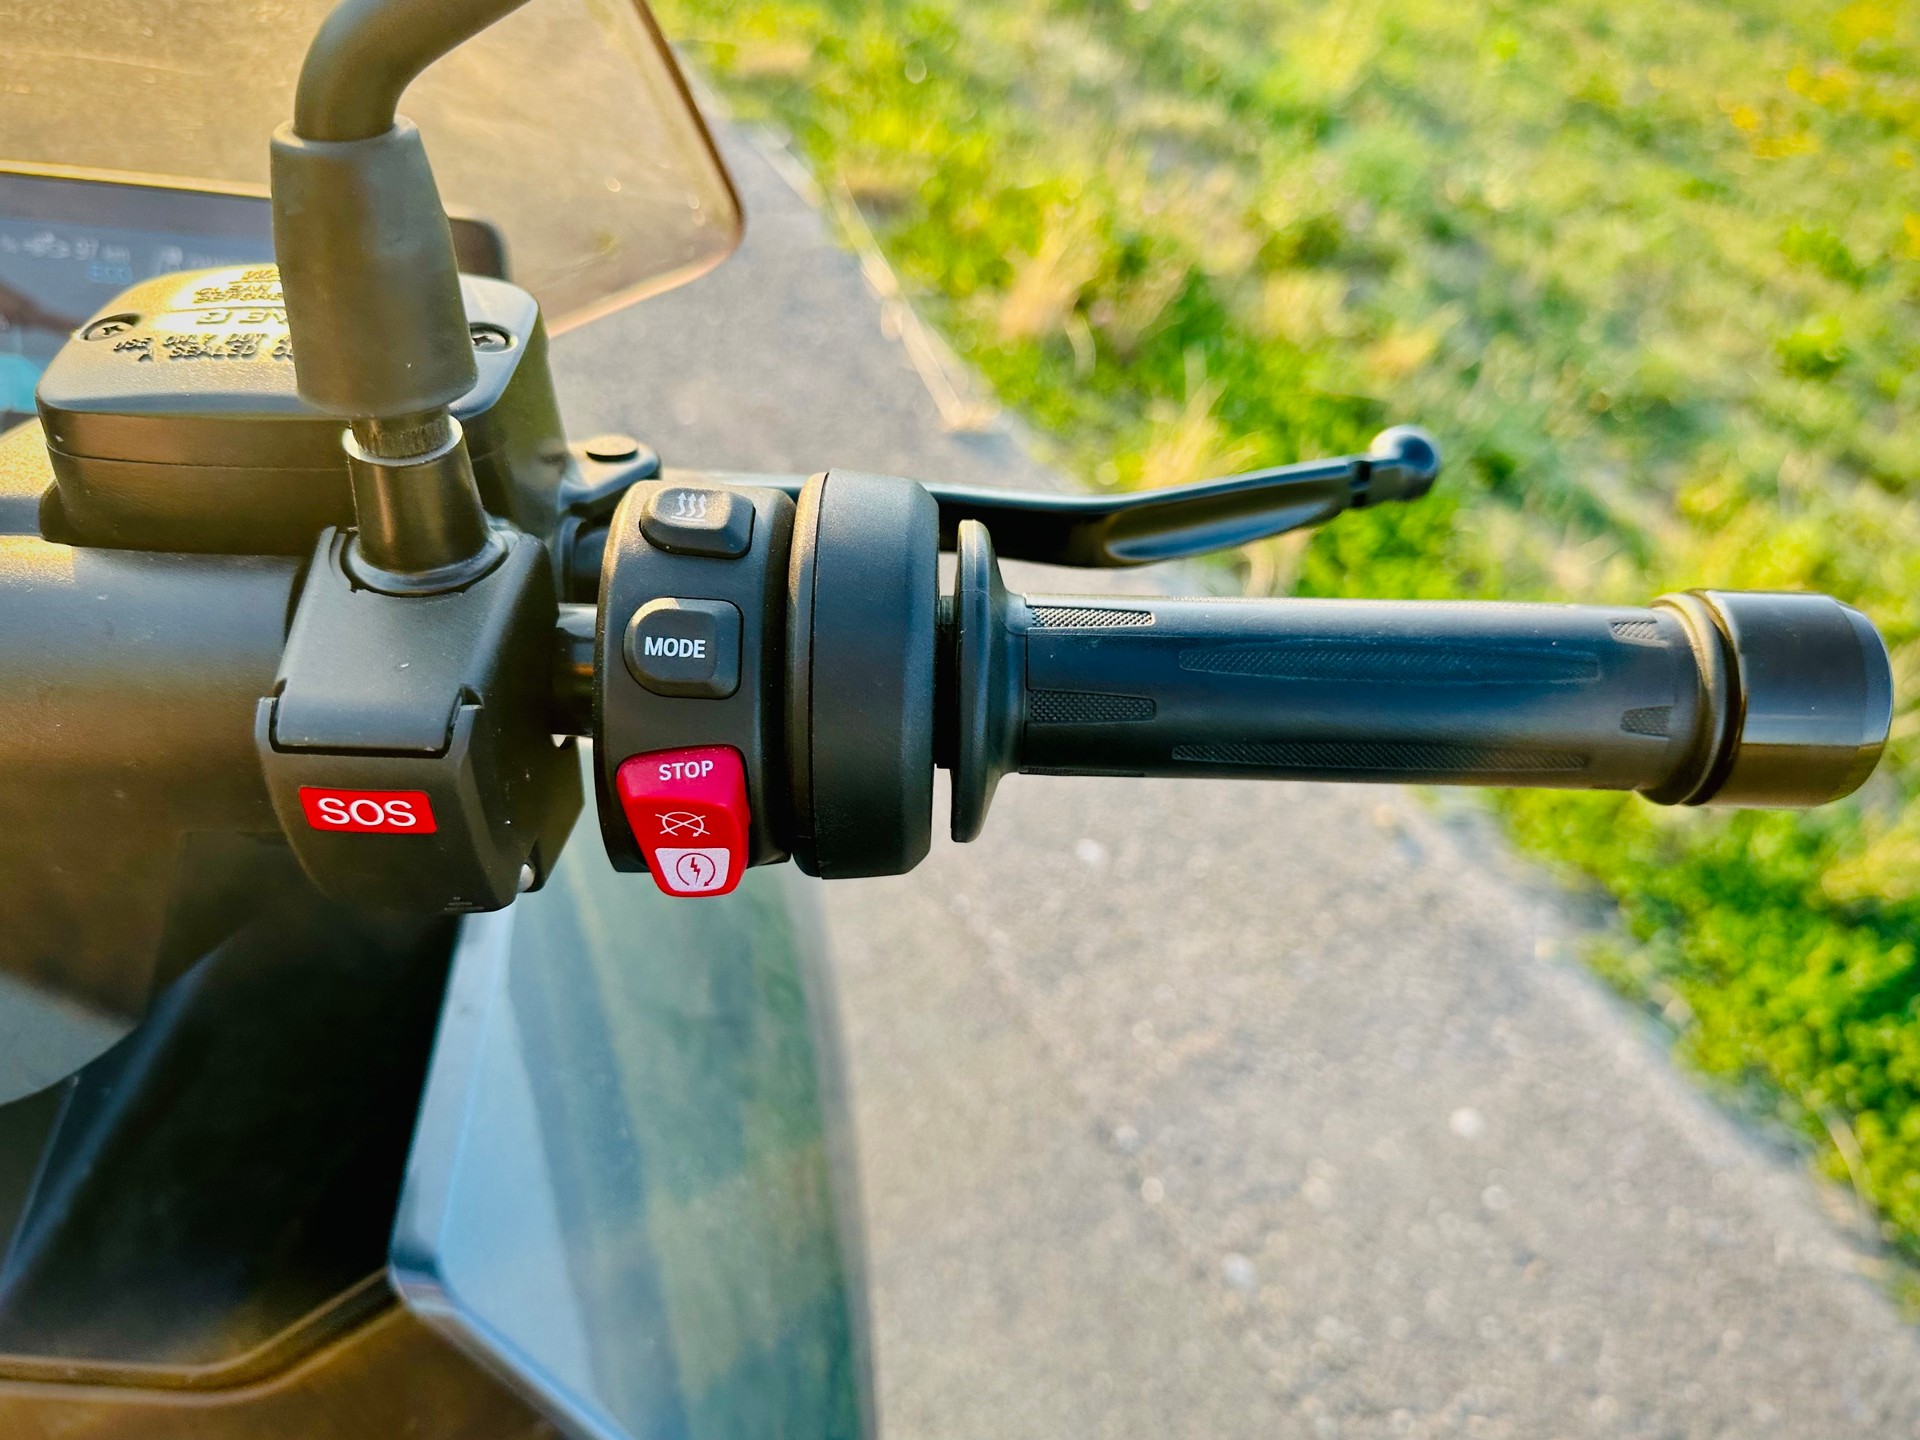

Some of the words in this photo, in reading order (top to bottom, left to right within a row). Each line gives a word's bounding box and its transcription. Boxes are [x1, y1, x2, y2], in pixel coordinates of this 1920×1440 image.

[114, 337, 154, 352] USE
[169, 345, 260, 361] SEALED
[644, 636, 706, 659] MODE
[658, 760, 714, 781] STOP
[317, 797, 417, 827] SOS
